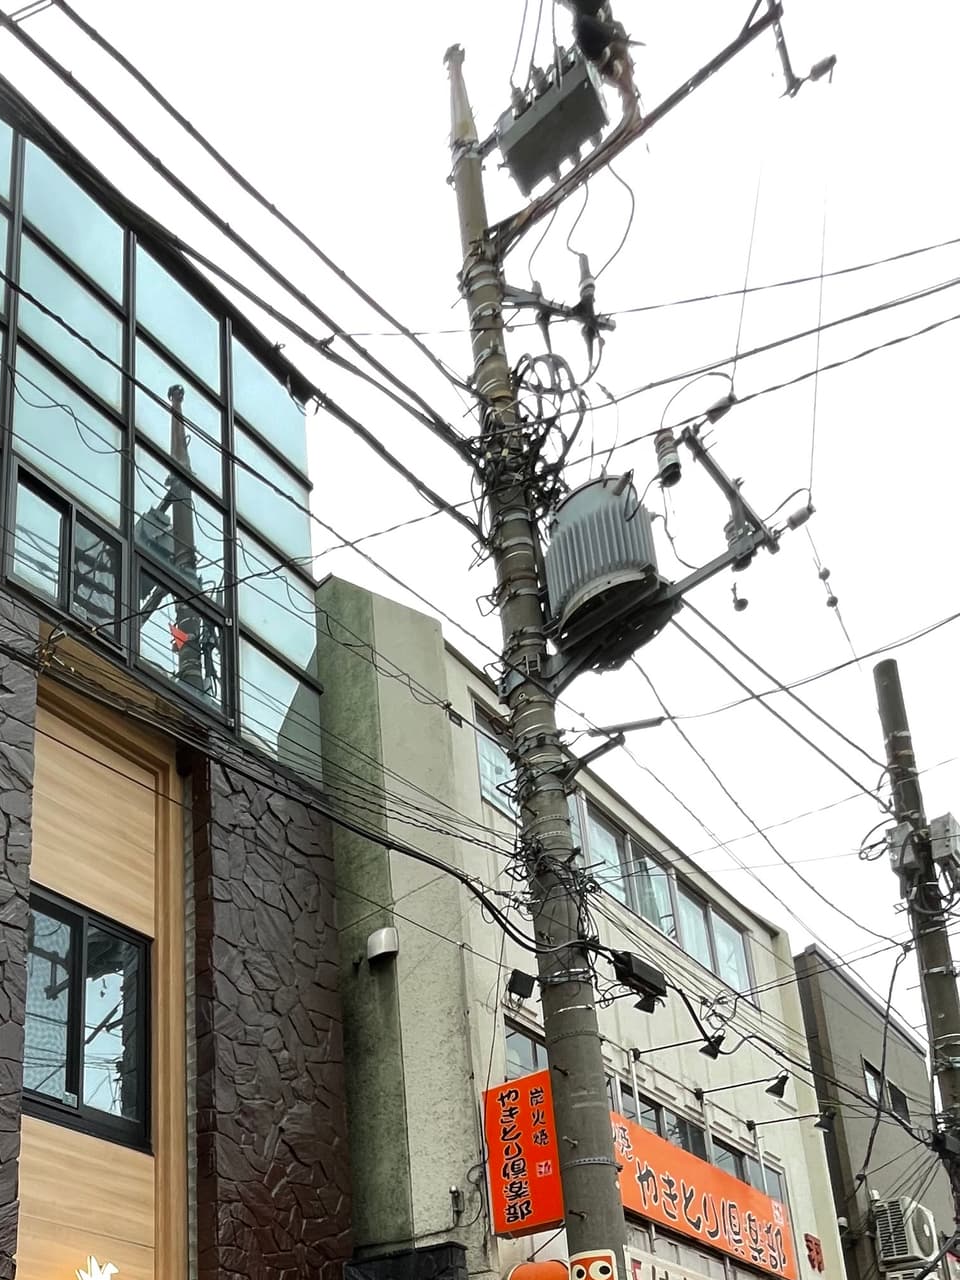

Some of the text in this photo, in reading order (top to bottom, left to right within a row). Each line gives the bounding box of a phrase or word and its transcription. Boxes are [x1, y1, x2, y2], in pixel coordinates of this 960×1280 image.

[497, 1089, 532, 1224] やきとり倶楽部
[529, 1087, 549, 1146] 炭火焼
[636, 1158, 787, 1274] やきとり倶楽部
